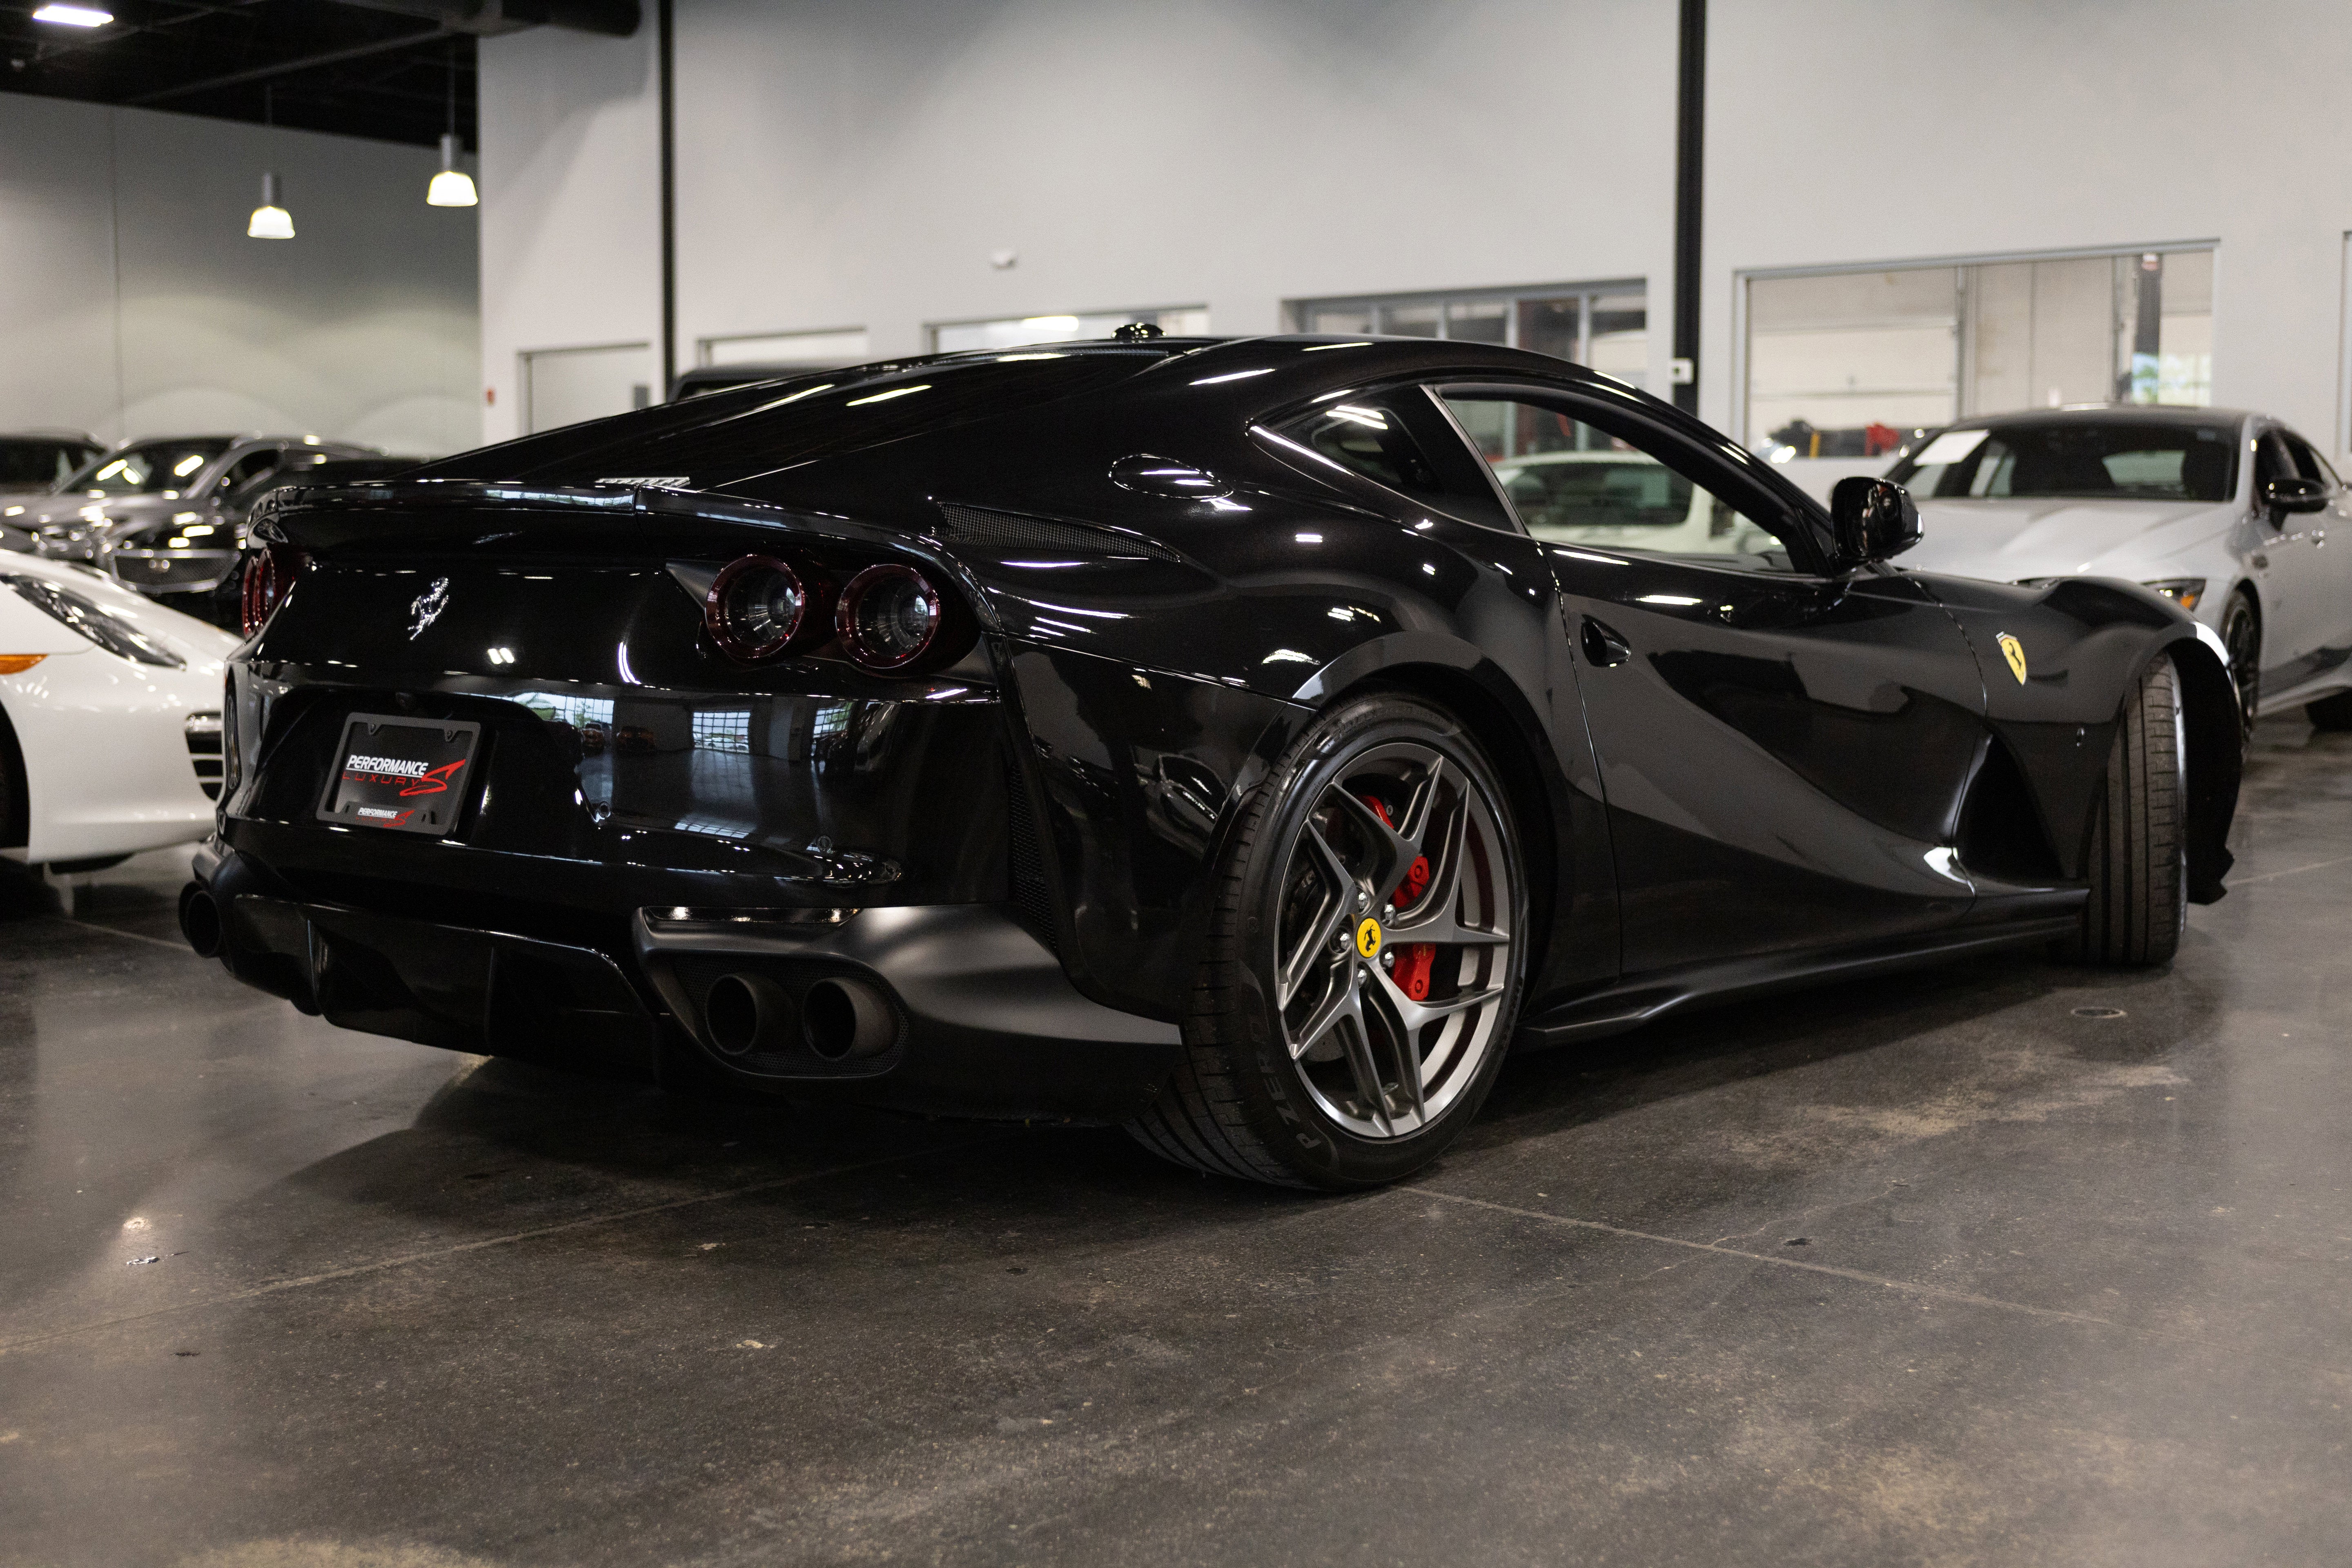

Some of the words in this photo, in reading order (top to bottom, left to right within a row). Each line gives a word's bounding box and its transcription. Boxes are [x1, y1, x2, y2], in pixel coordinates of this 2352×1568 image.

[347, 754, 429, 775] PERFORMANCE
[342, 771, 420, 786] LUXURY
[358, 807, 398, 817] PERFORMANCE
